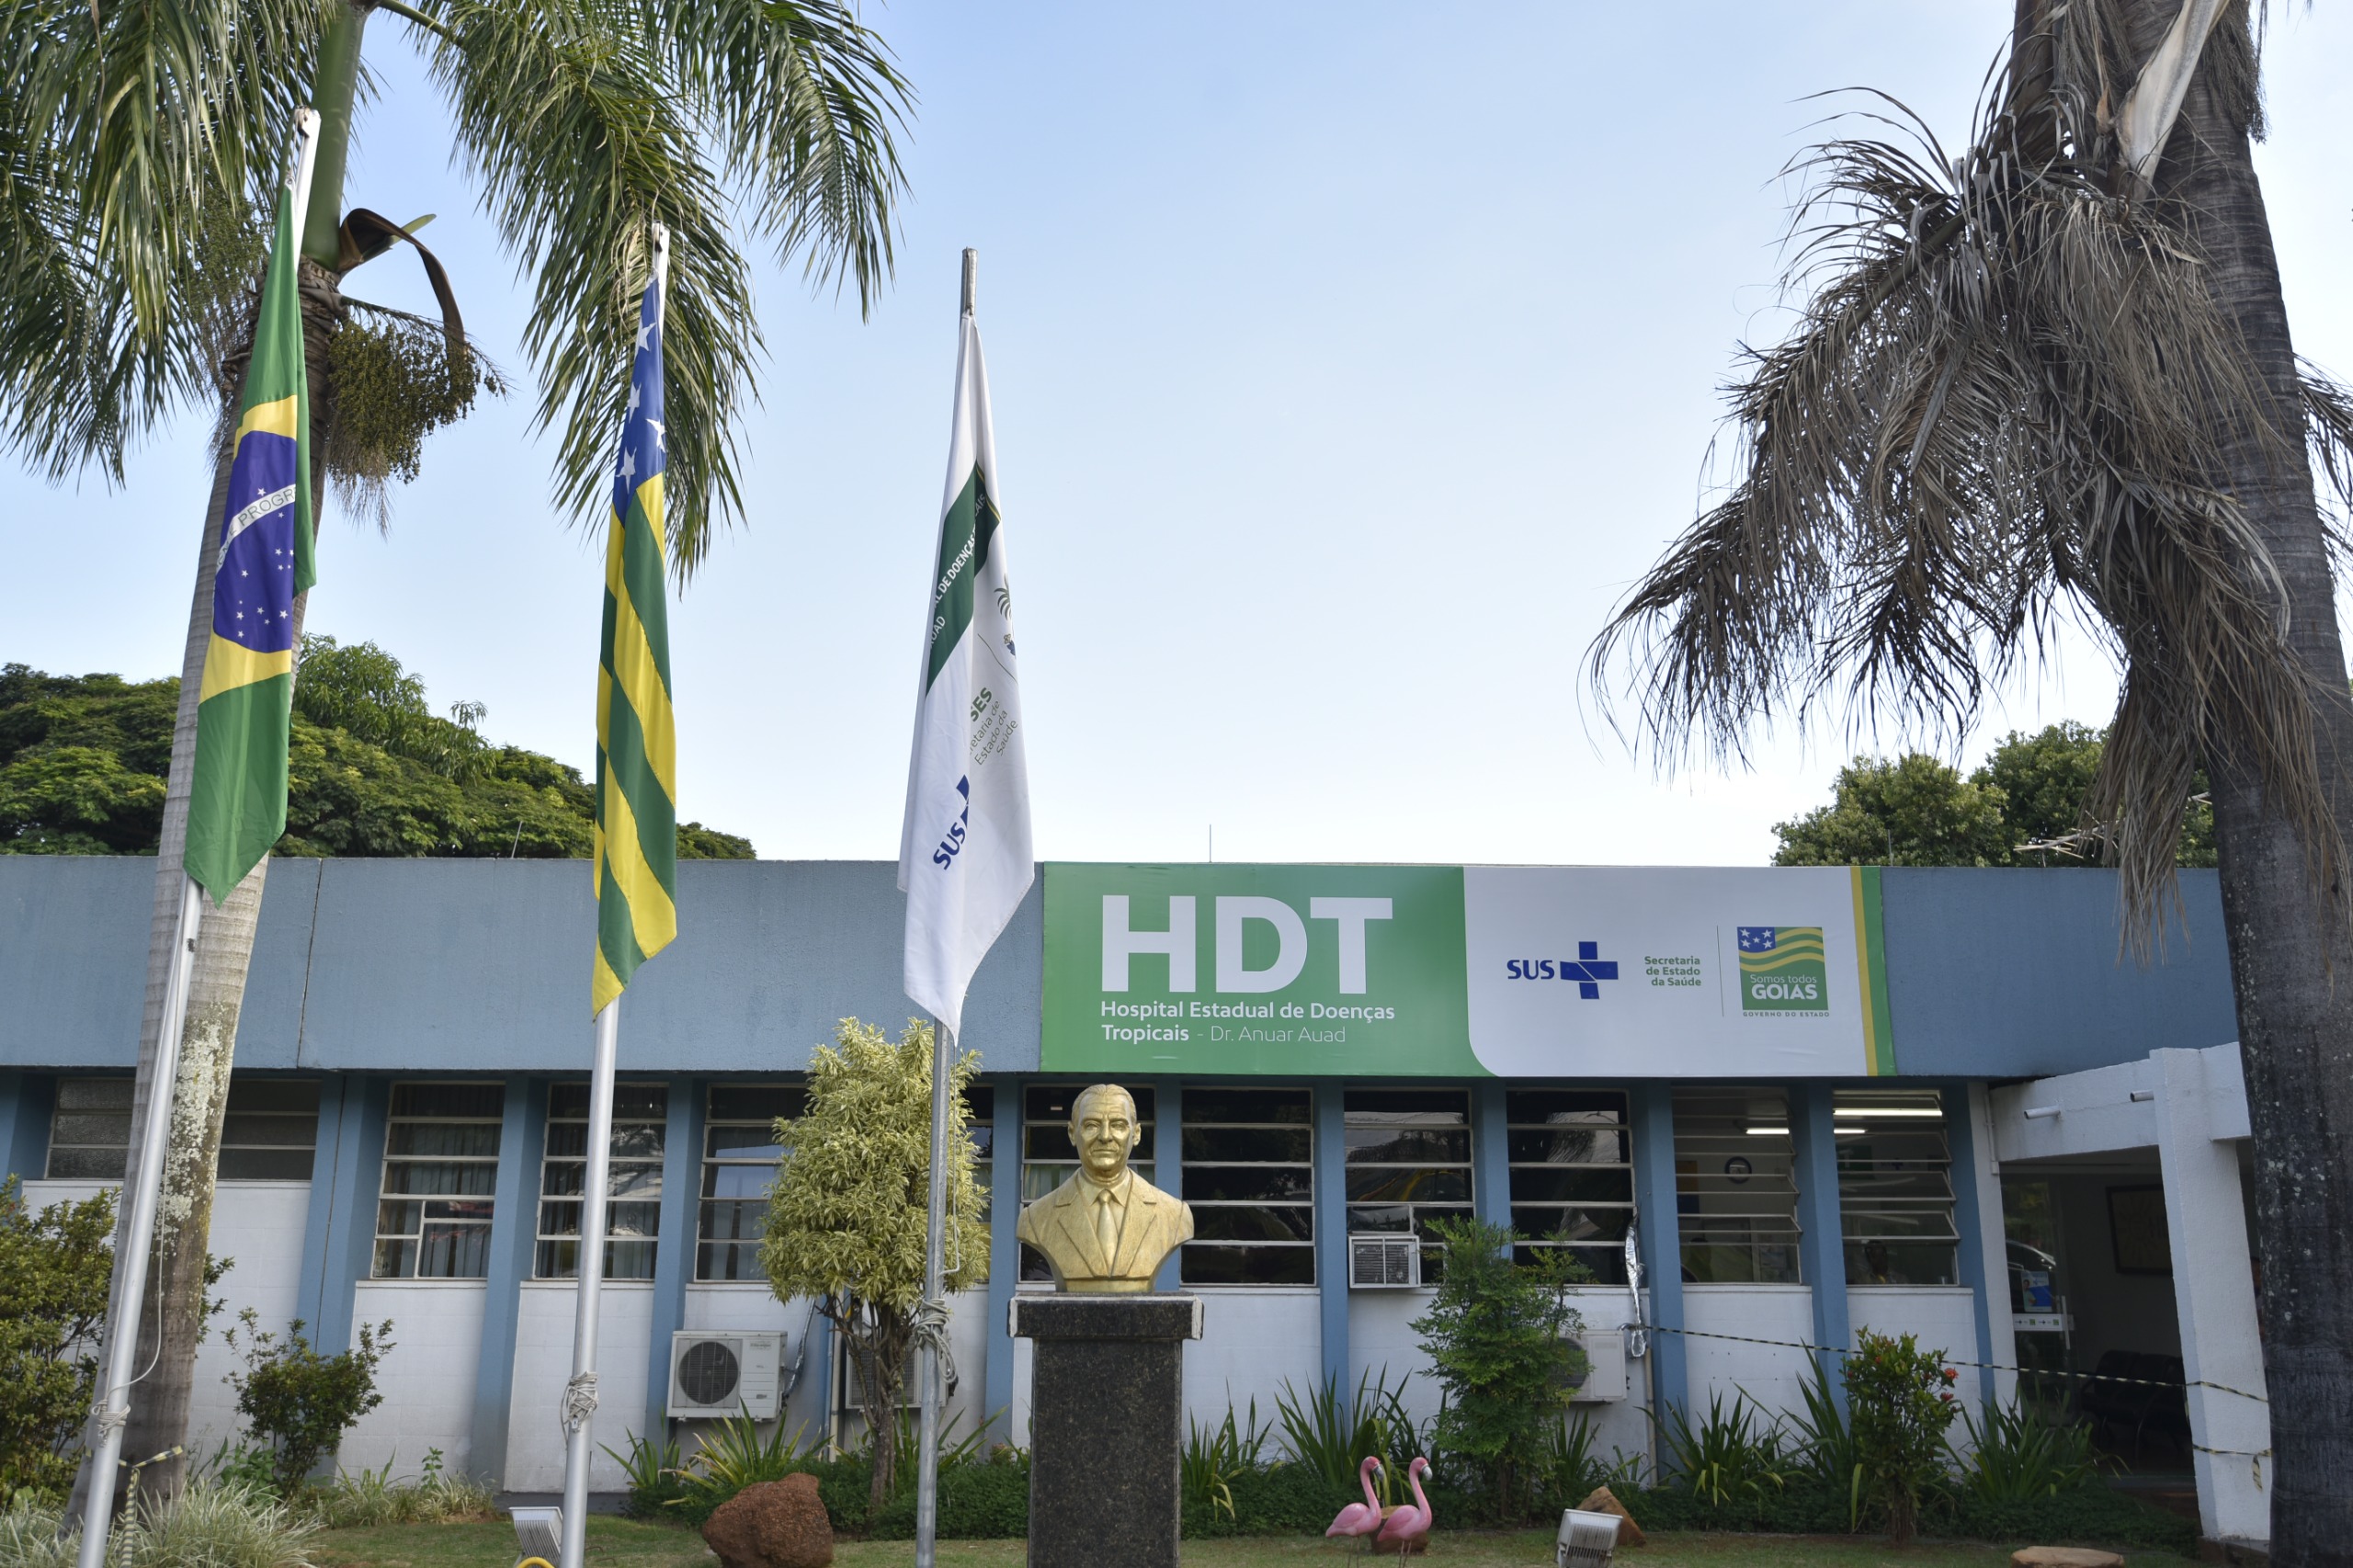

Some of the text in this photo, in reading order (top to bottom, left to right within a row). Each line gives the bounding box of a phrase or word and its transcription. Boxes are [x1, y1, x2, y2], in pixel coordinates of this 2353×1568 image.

[938, 576, 952, 594] DE
[992, 700, 1000, 716] de
[974, 710, 1008, 766] Estado da
[996, 720, 1018, 756] Saúde
[933, 822, 966, 870] SUS
[1101, 894, 1393, 994] HDT
[1506, 959, 1555, 981] SUS
[1644, 956, 1700, 965] Secretaria
[1645, 966, 1700, 976] de Estado
[1651, 976, 1701, 986] da Saúde
[1749, 974, 1817, 983] Somos todos
[1101, 1001, 1395, 1024] Hospital Estadual de Doenças
[1101, 1024, 1189, 1045] Tropicais
[1211, 1025, 1234, 1041] Dr.
[1238, 1026, 1294, 1042] Anuar
[1298, 1026, 1346, 1042] Auad
